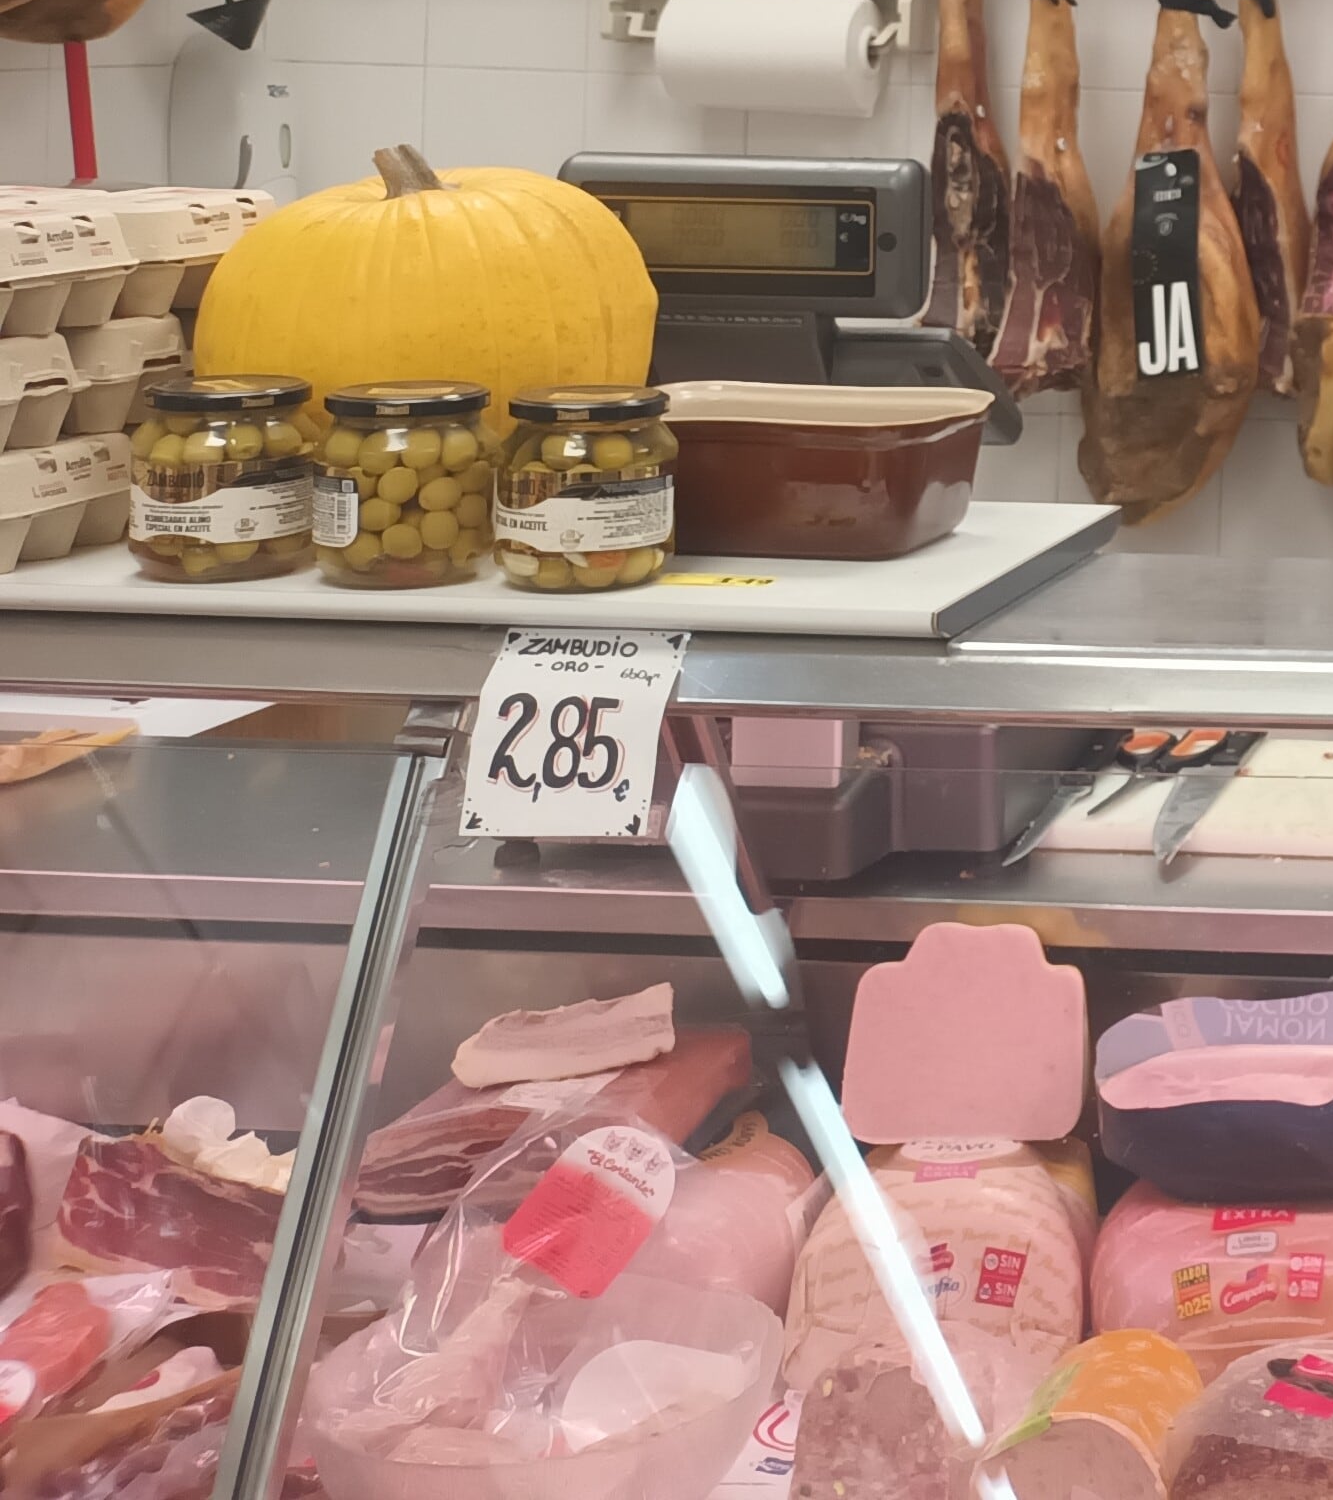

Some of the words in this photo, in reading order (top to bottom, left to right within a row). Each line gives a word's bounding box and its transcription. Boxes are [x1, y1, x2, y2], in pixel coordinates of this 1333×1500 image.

[1138, 280, 1199, 376] JA
[550, 660, 590, 673] ORO
[487, 691, 624, 804] 2,85
[1221, 1208, 1290, 1222] EXTRA
[999, 1255, 1022, 1270] SIN
[1176, 1263, 1208, 1283] SABOR
[994, 1282, 1017, 1297] SIN
[1176, 1294, 1212, 1320] 2025
